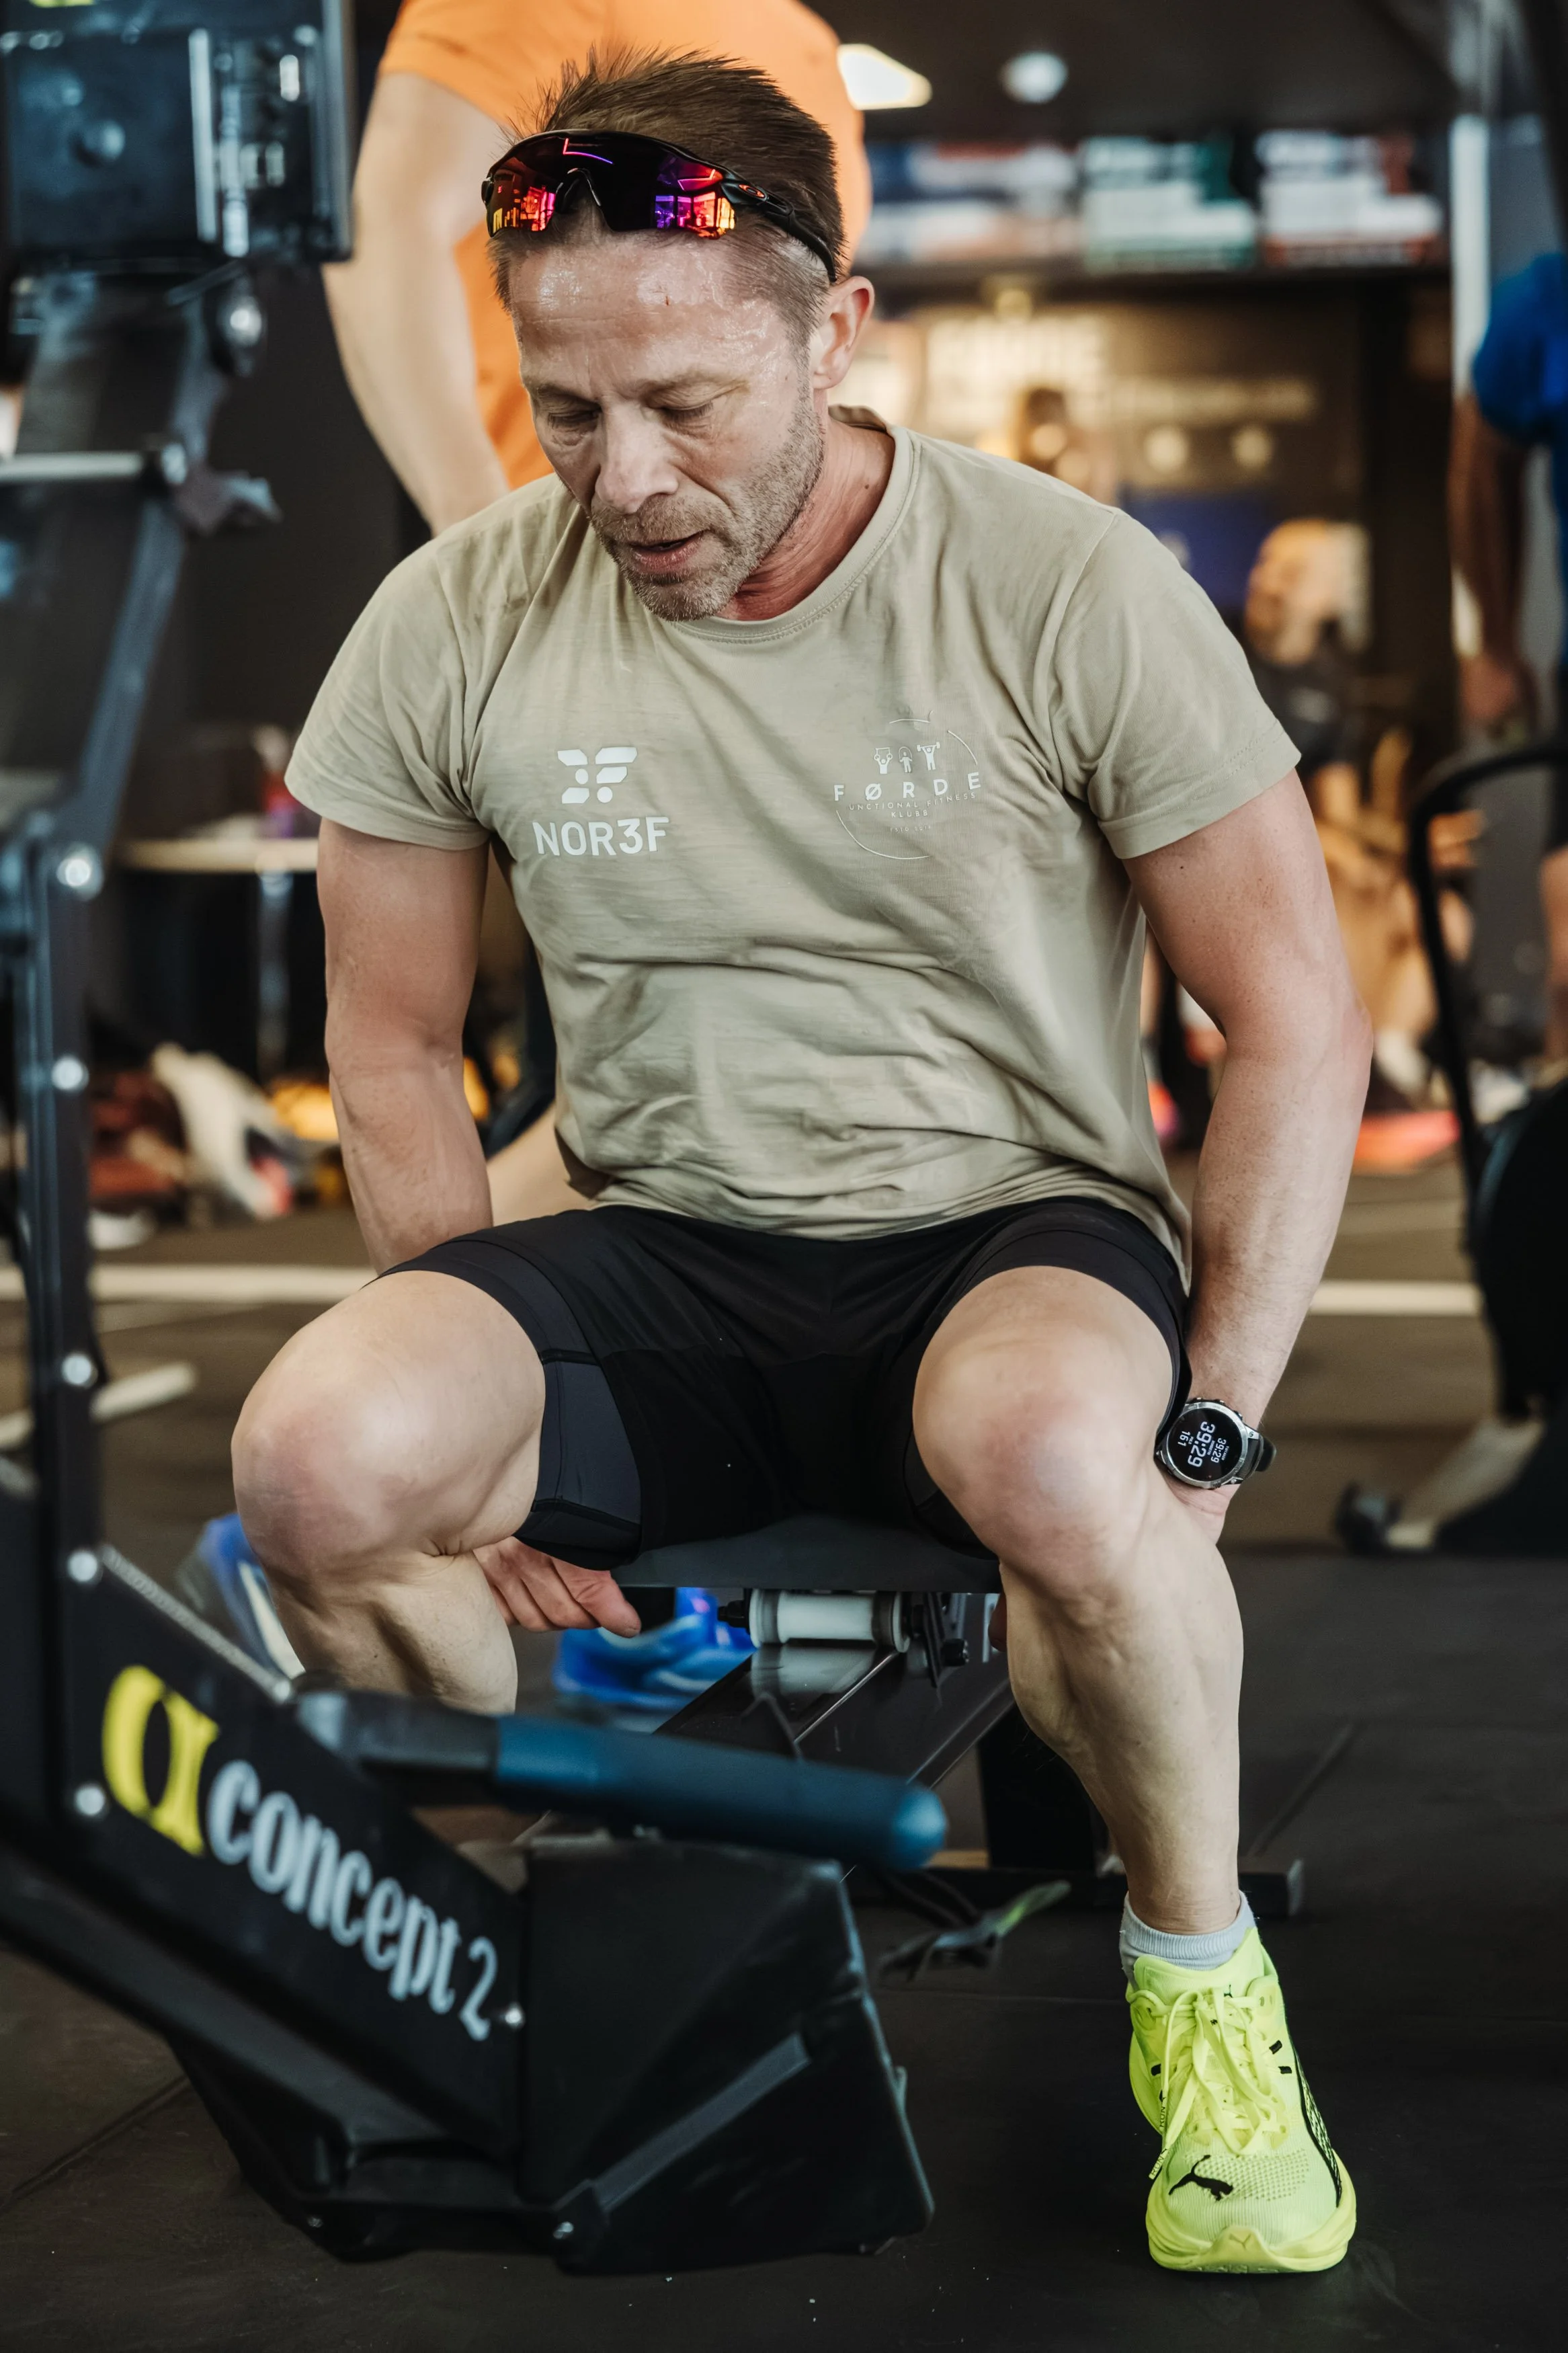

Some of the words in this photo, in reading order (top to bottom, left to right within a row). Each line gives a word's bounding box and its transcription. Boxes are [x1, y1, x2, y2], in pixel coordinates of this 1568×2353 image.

[833, 772, 981, 801] FØRDE
[927, 792, 976, 807] FITNESS
[891, 809, 928, 818] KLUBB
[532, 816, 669, 856] NOR3F
[1178, 1431, 1191, 1447] 161
[1187, 1421, 1216, 1468] 39:29
[1210, 1437, 1227, 1464] 39:29
